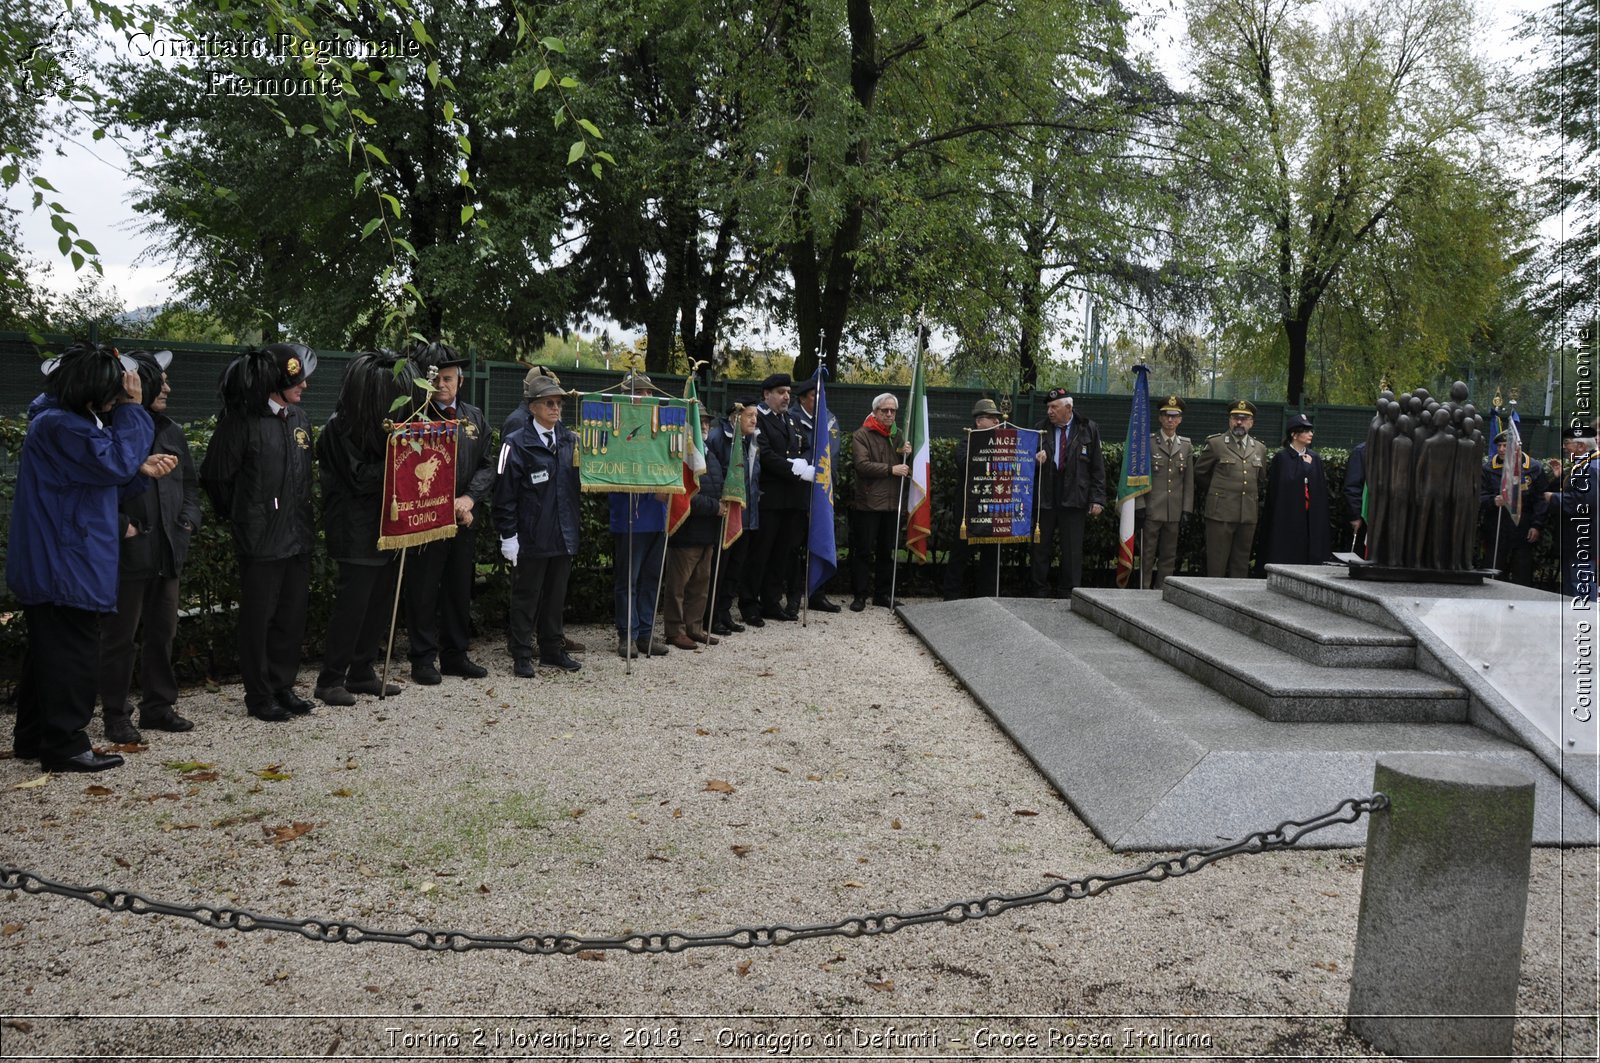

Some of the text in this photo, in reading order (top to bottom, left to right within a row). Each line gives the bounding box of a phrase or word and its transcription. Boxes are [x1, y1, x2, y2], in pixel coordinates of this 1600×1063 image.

[585, 461, 678, 476] SEZIONE DI TORINO
[397, 501, 415, 512] EZIONE
[408, 512, 437, 527] TORINO
